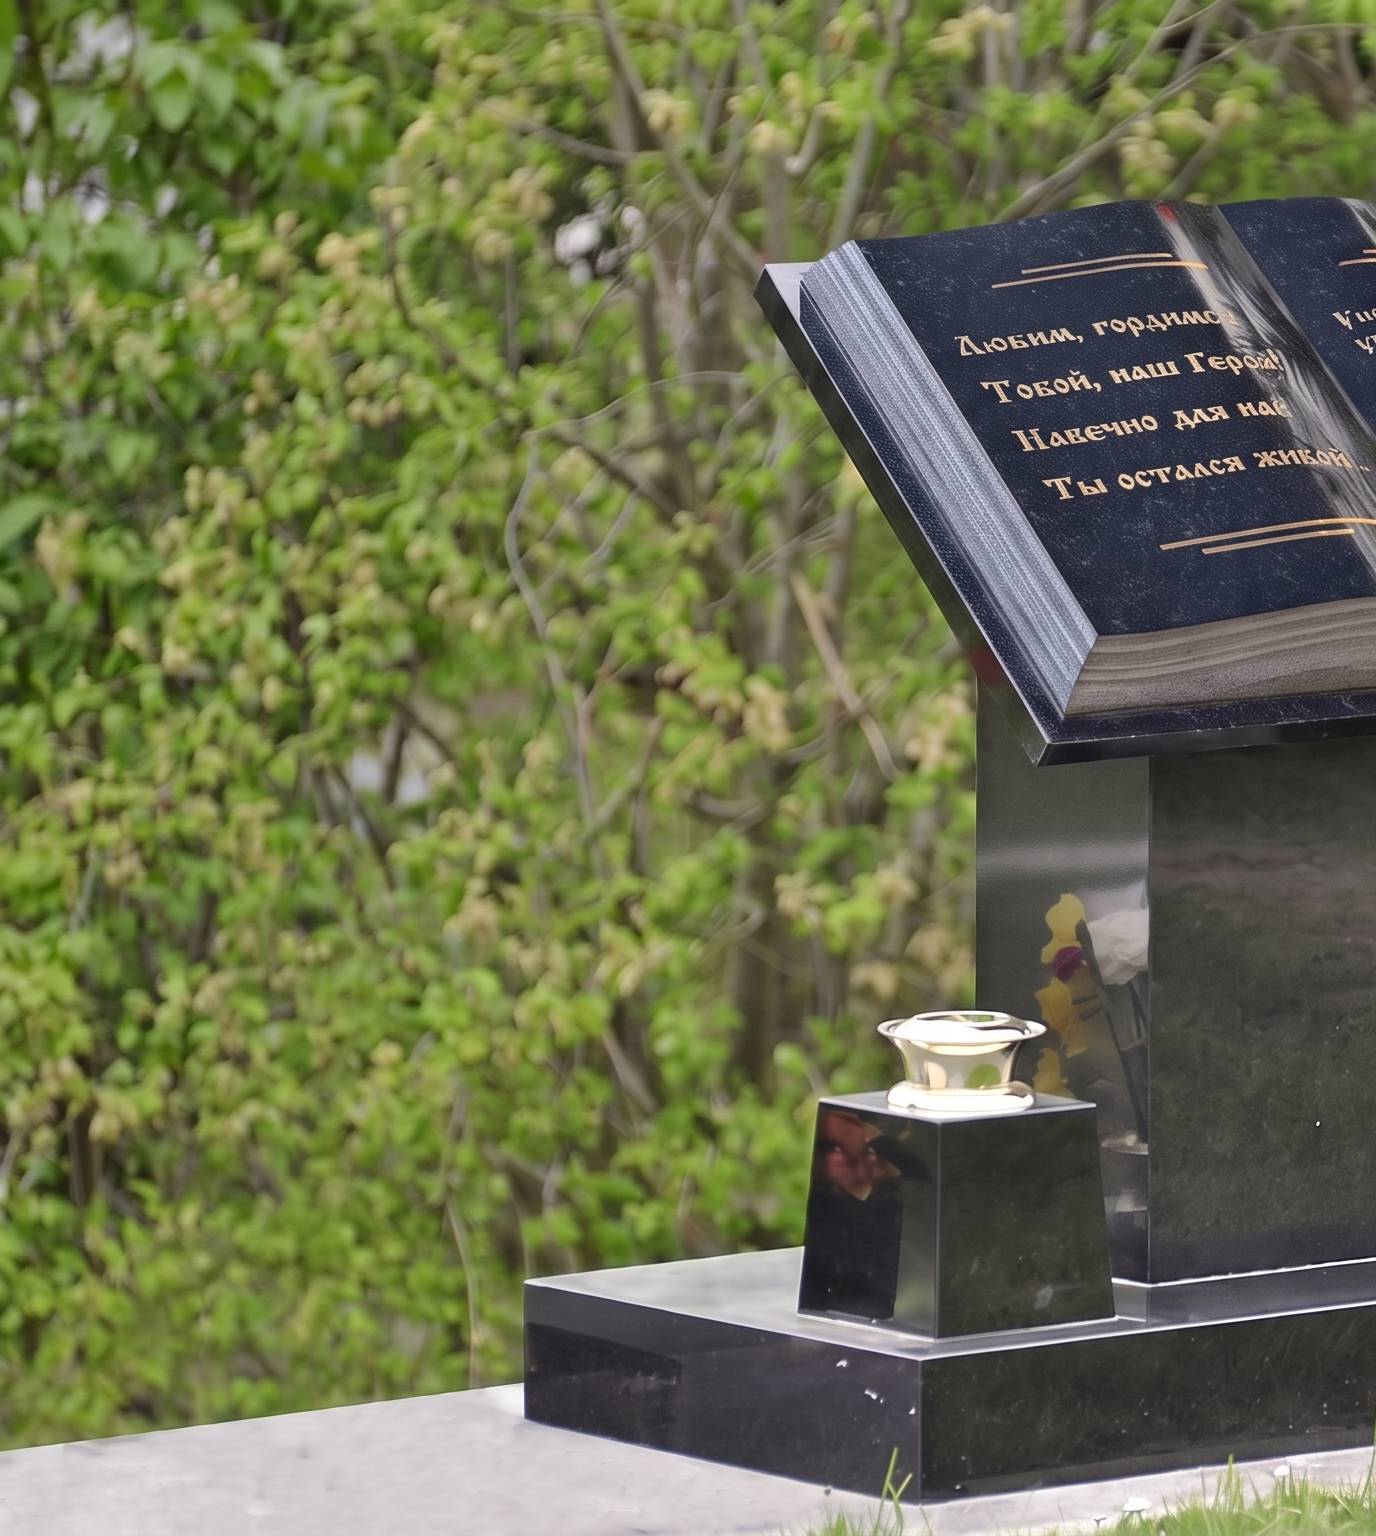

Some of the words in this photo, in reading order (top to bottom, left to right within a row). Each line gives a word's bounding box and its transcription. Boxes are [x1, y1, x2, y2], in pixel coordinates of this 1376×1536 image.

[955, 326, 1084, 356] Любим,
[1092, 311, 1238, 338] гордимся
[980, 370, 1102, 403] Тобой,
[1109, 360, 1180, 384] наш
[1011, 415, 1158, 451] Навечно
[1173, 405, 1230, 431] для
[1236, 397, 1292, 418] нас
[1042, 476, 1108, 501] Ты
[1118, 455, 1247, 490] остался
